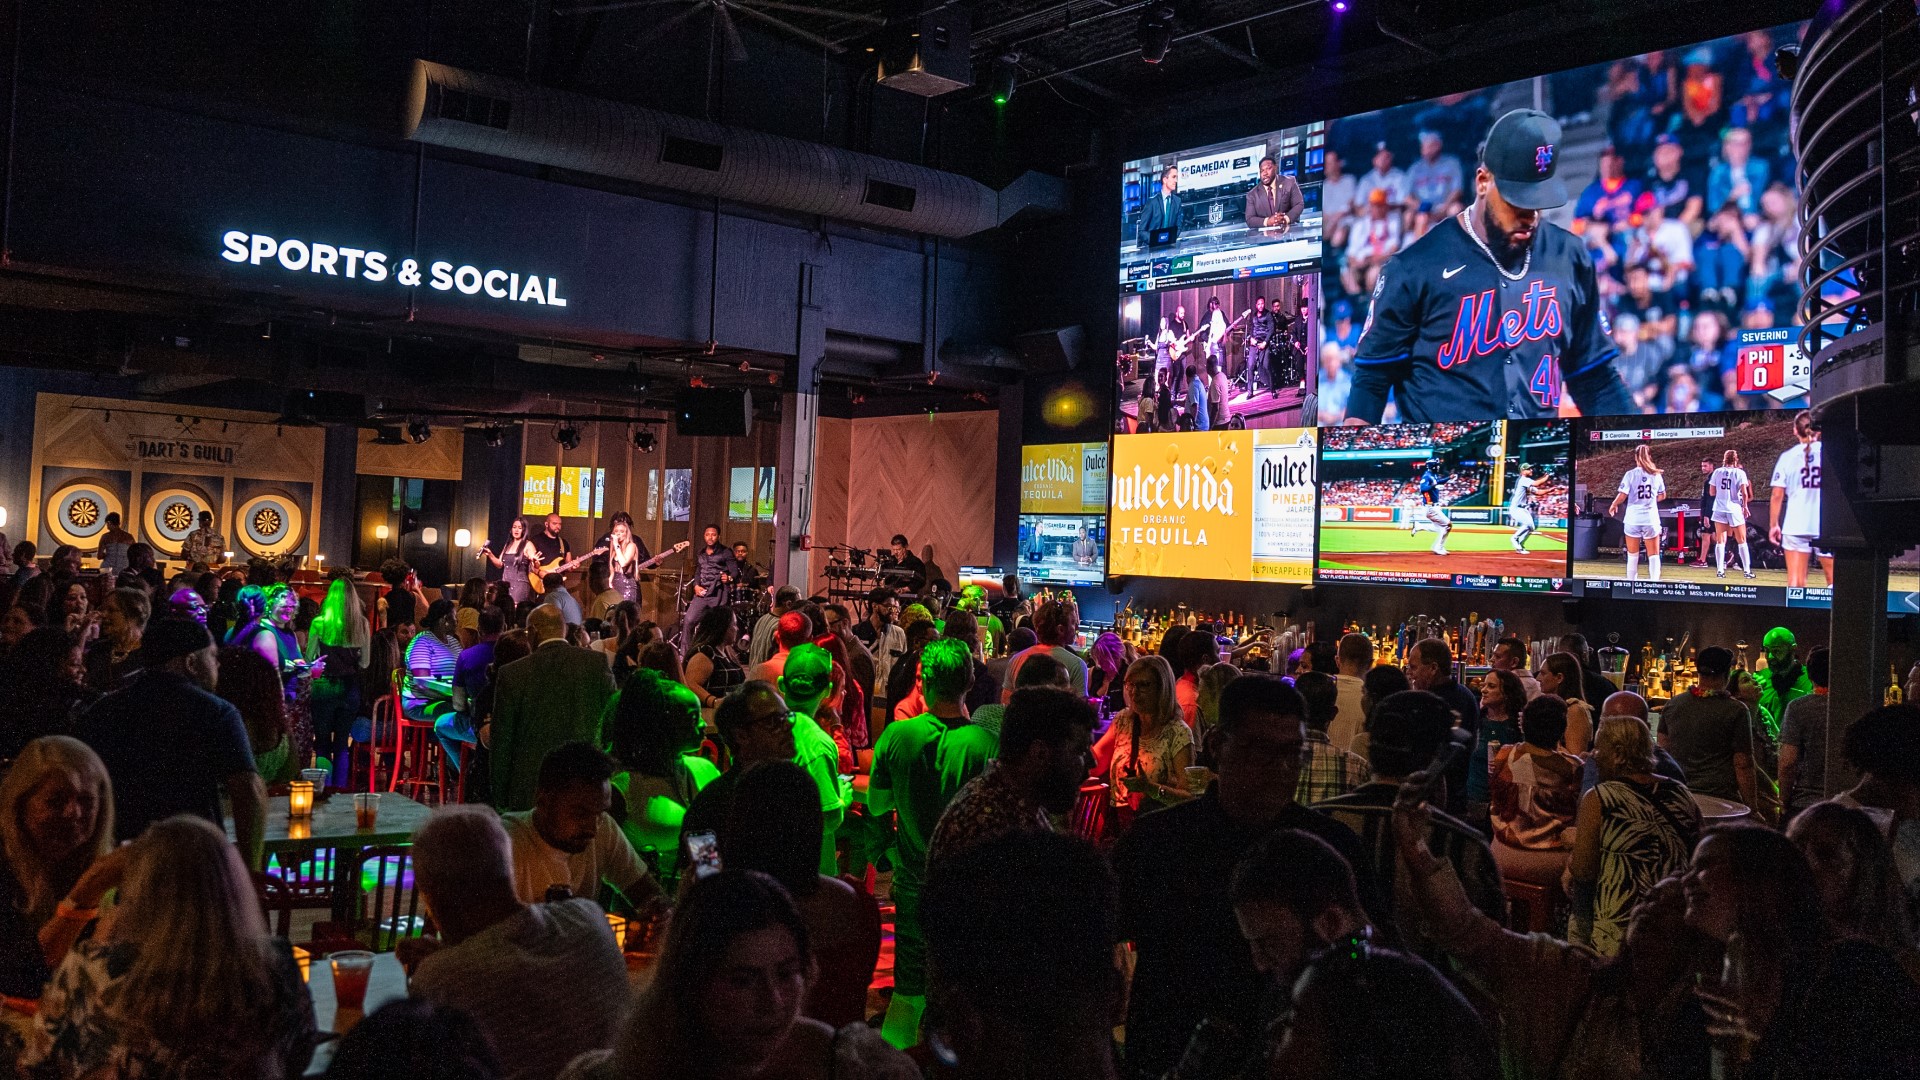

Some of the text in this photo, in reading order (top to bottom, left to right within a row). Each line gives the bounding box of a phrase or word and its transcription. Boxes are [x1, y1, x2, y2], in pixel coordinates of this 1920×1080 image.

[1190, 159, 1230, 175] GAMEDAY
[221, 230, 567, 307] SPORTS & SOCIAL
[1196, 259, 1215, 268] Players
[1238, 253, 1257, 262] tonight
[1437, 280, 1562, 370] Mets
[1742, 330, 1788, 342] SEVERINO
[1748, 350, 1773, 365] PHI
[1753, 367, 1767, 387] 0
[139, 440, 234, 464] DART'S GUILD
[1047, 458, 1074, 484] Vida
[1085, 453, 1106, 471] Dulce
[1261, 454, 1308, 491] Dulce
[1800, 466, 1822, 488] 22
[1023, 490, 1063, 499] TEQUILA
[1173, 463, 1234, 516] Vida
[1272, 493, 1314, 504] PINEAP
[1637, 484, 1652, 499] 23
[1143, 514, 1186, 524] ORGANIC
[1120, 527, 1208, 546] TEQUILA
[1261, 565, 1301, 576] PINEAPPLE
